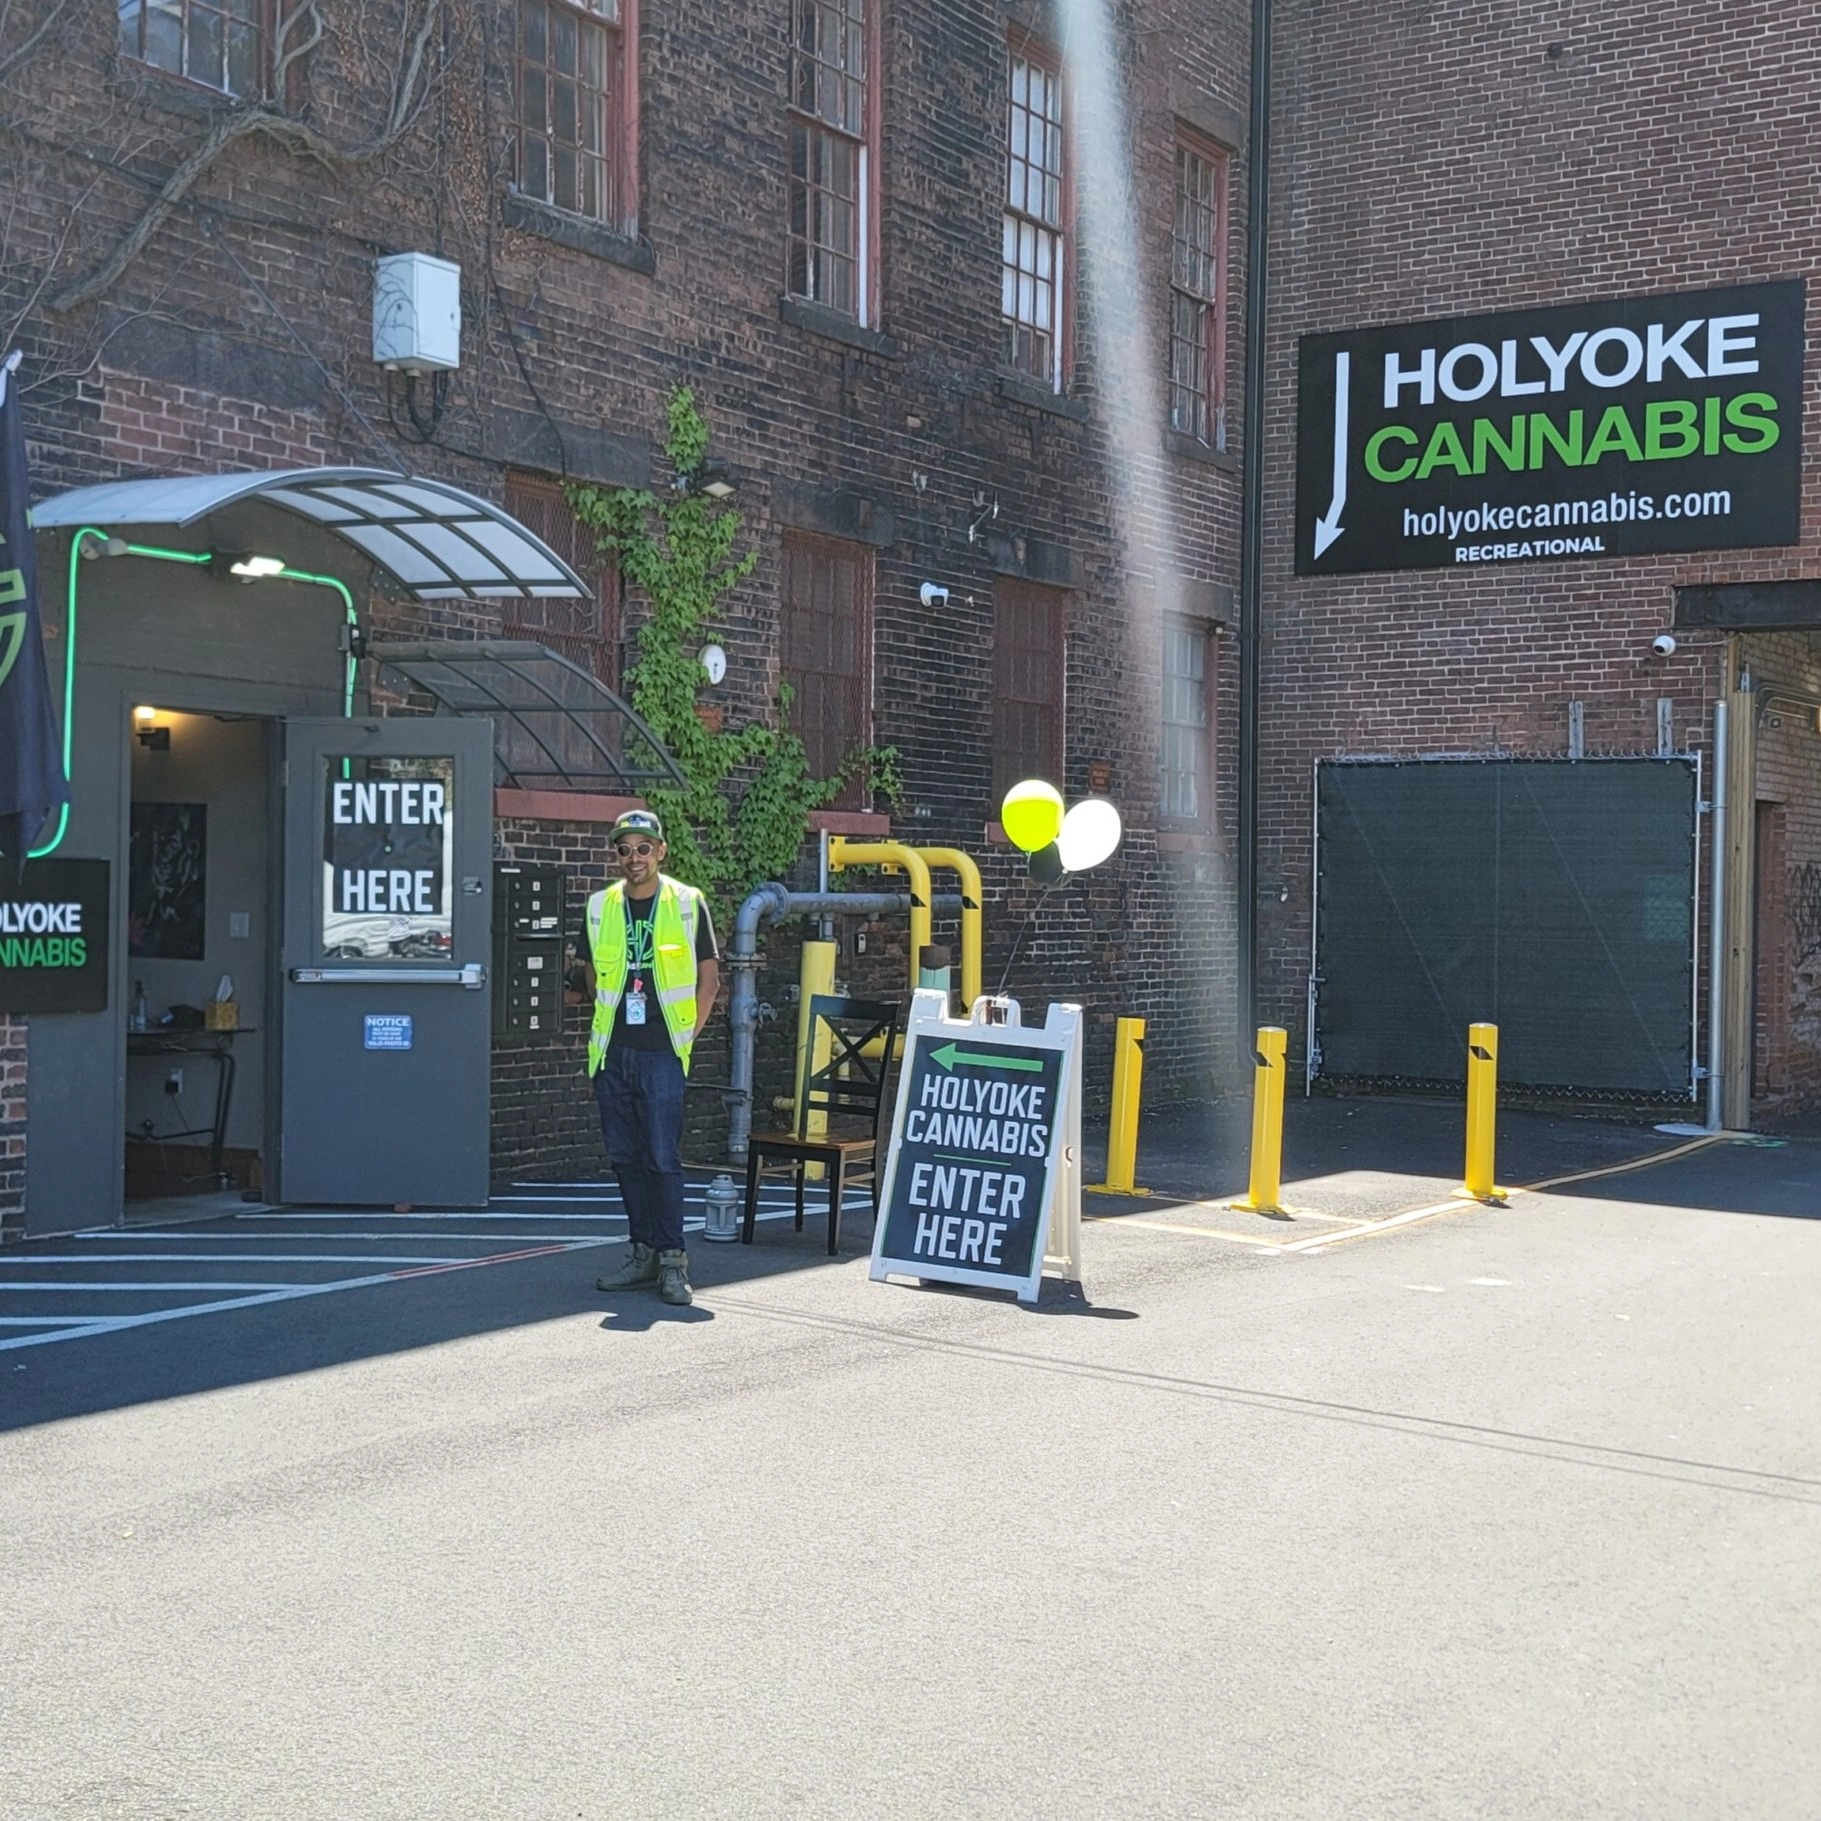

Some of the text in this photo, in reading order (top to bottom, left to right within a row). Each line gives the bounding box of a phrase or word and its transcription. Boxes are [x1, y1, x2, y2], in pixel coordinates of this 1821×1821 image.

[1383, 313, 1760, 409] HOLYOKE
[1363, 391, 1781, 483] CANNABIS
[1403, 489, 1732, 540] holyokecannabis.com
[1455, 536, 1606, 563] RECREATIONAL
[333, 782, 445, 825] ENTER
[342, 869, 435, 912] HERE
[0, 902, 82, 933] LYOKE
[367, 1017, 410, 1027] NOTICE
[920, 1073, 1046, 1120] HOLYOKE
[906, 1110, 1049, 1158] CANNABIS
[908, 1162, 1027, 1219] ENTER
[913, 1212, 1008, 1266] HERE
